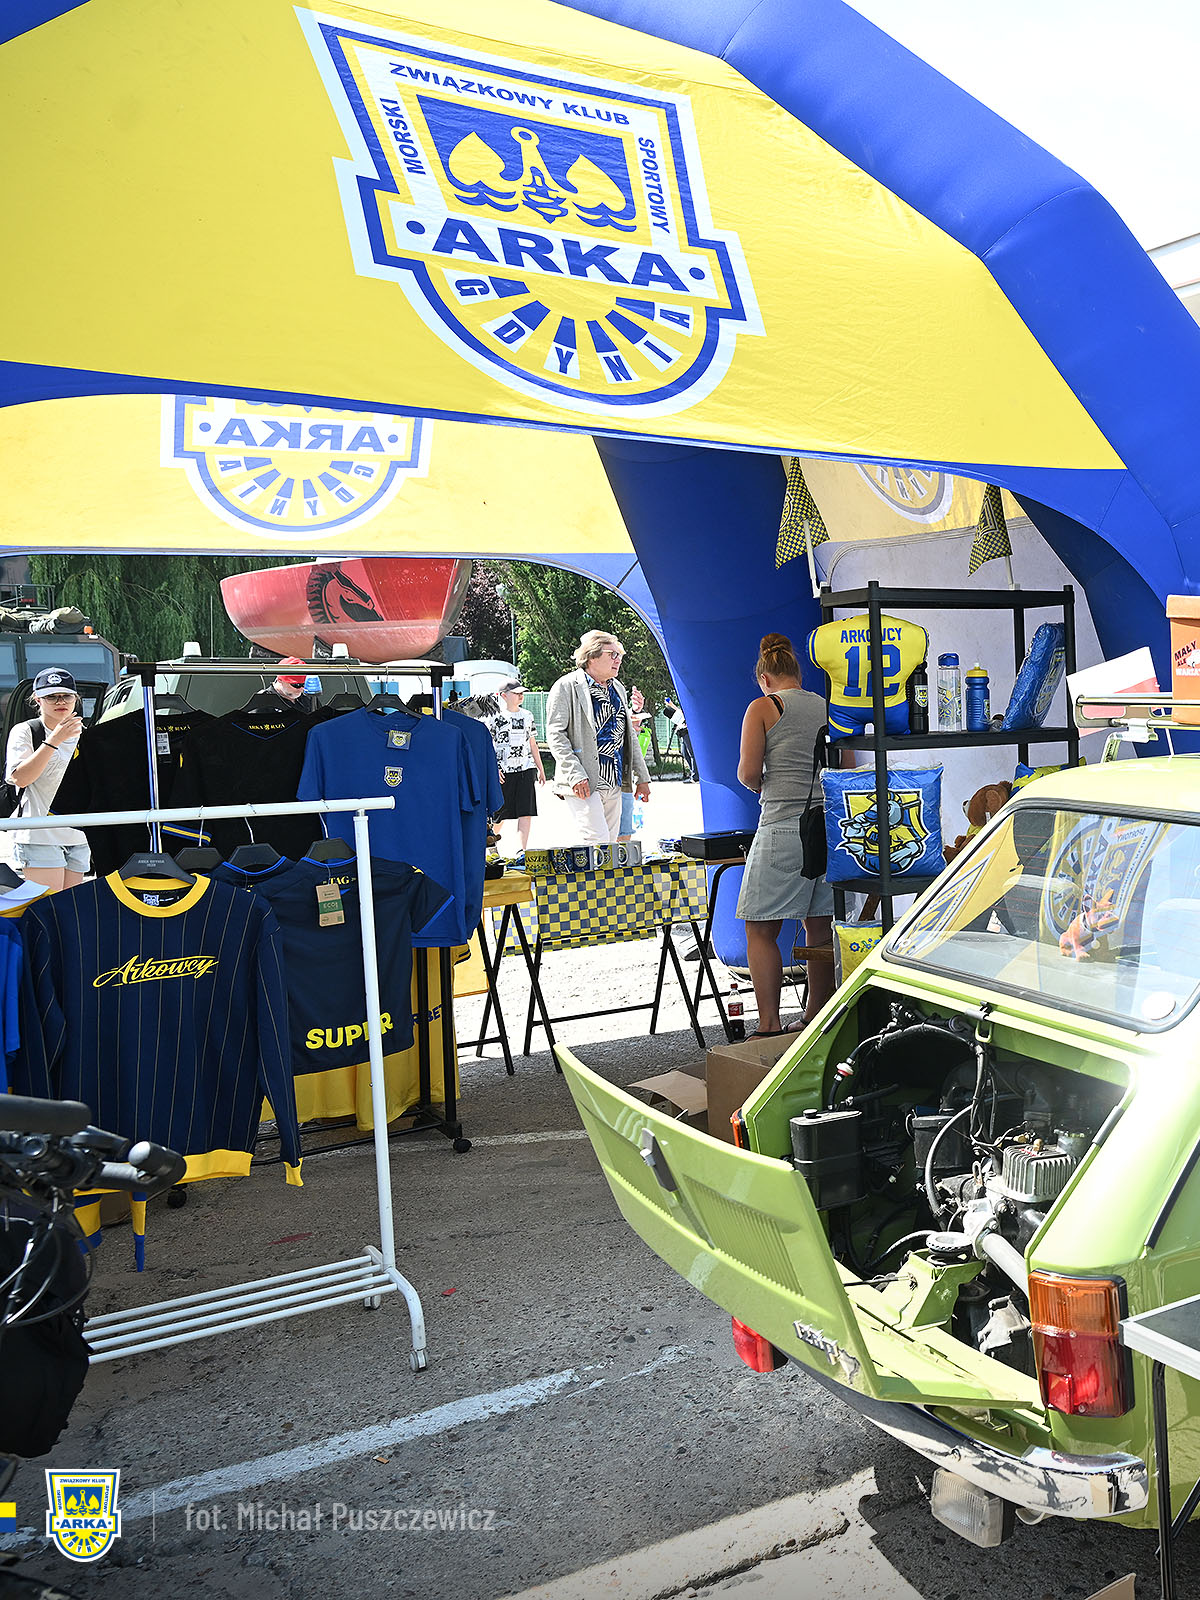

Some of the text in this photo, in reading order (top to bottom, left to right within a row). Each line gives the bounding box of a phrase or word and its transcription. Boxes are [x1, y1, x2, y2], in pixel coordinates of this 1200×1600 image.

[389, 62, 630, 126] ZWIĄZKOWY KLUB
[379, 98, 426, 175] MORSKI
[638, 136, 672, 234] SPORTOWY
[432, 217, 690, 292] ARKA
[457, 277, 690, 381] GDYNIA
[93, 954, 219, 988] Arkowcy
